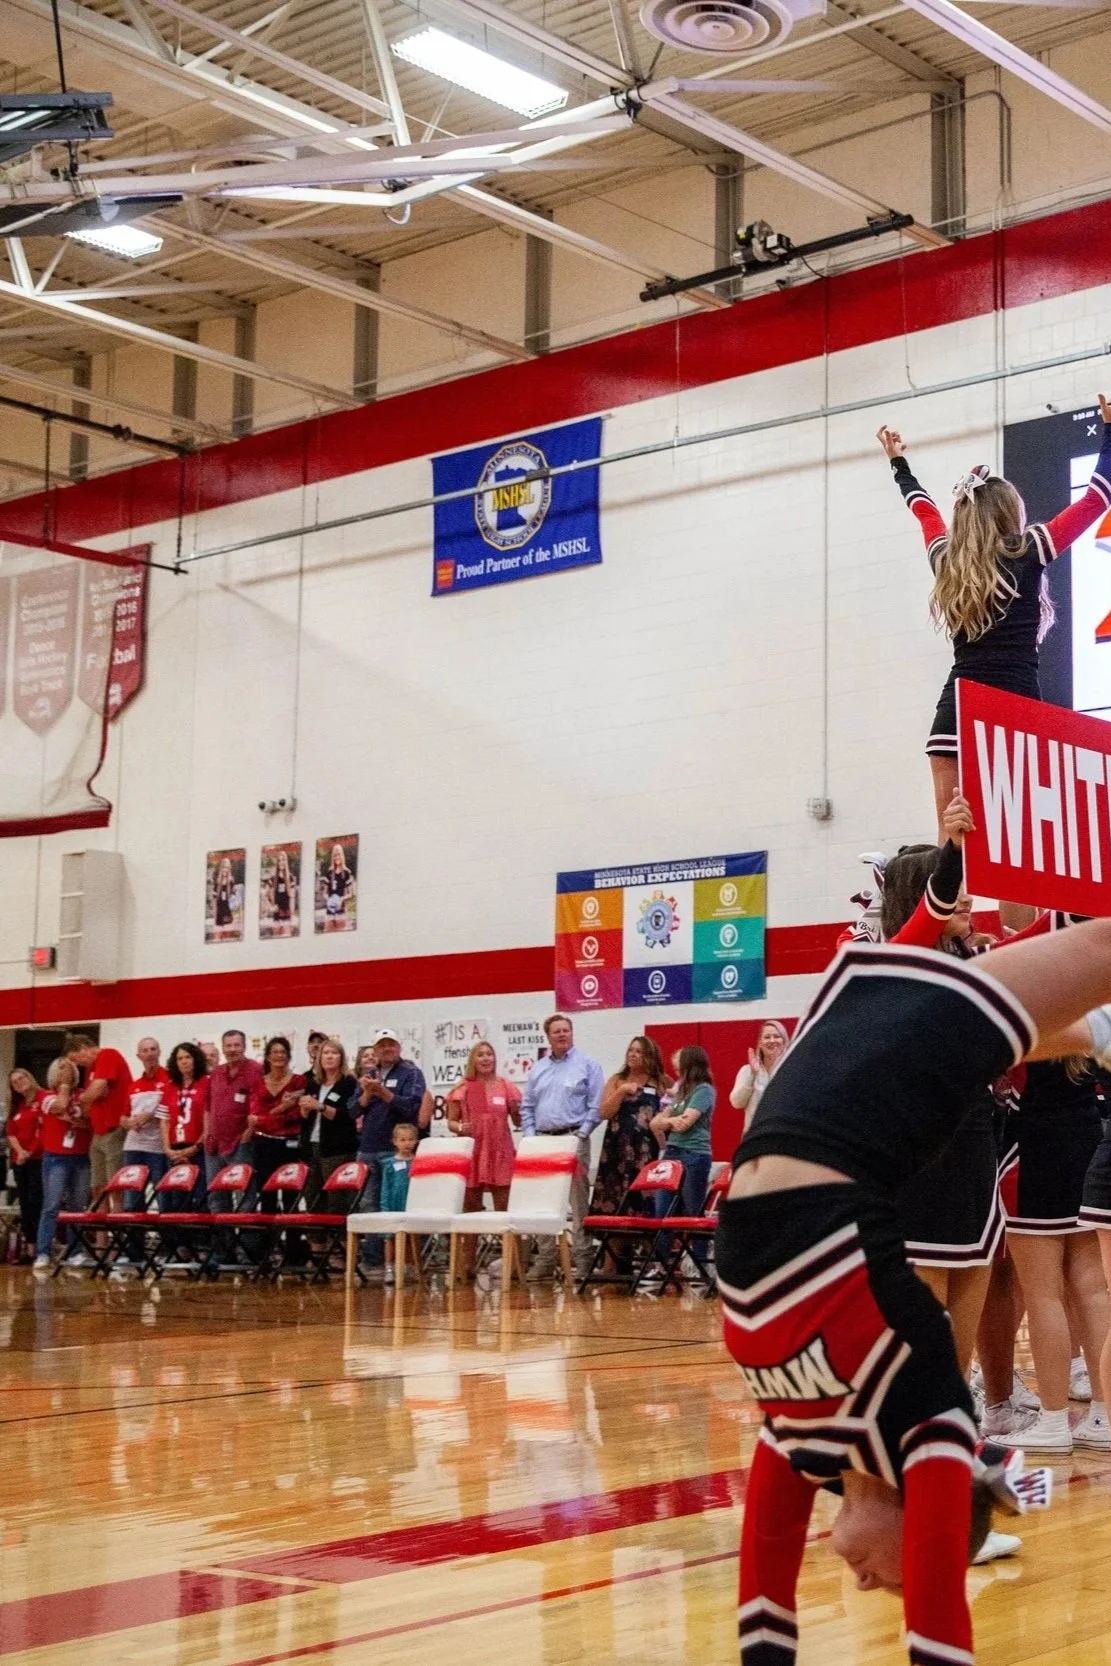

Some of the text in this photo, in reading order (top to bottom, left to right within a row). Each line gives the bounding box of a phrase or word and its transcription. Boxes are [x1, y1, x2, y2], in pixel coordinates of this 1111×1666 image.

[456, 562, 485, 580] Proud
[486, 556, 520, 574] Partner
[522, 549, 533, 565] of
[535, 546, 550, 562] the
[552, 537, 590, 559] MSHSL
[594, 858, 727, 879] MINNESOTA STATE HIGH SCHOOL LEAGUE
[594, 867, 726, 889] BEHAVIOR EXPECTATIONS
[455, 1024, 465, 1041] IS
[471, 1023, 482, 1040] A
[508, 1035, 526, 1045] LAST
[432, 1065, 466, 1082] WEA
[738, 1336, 852, 1400] MWH
